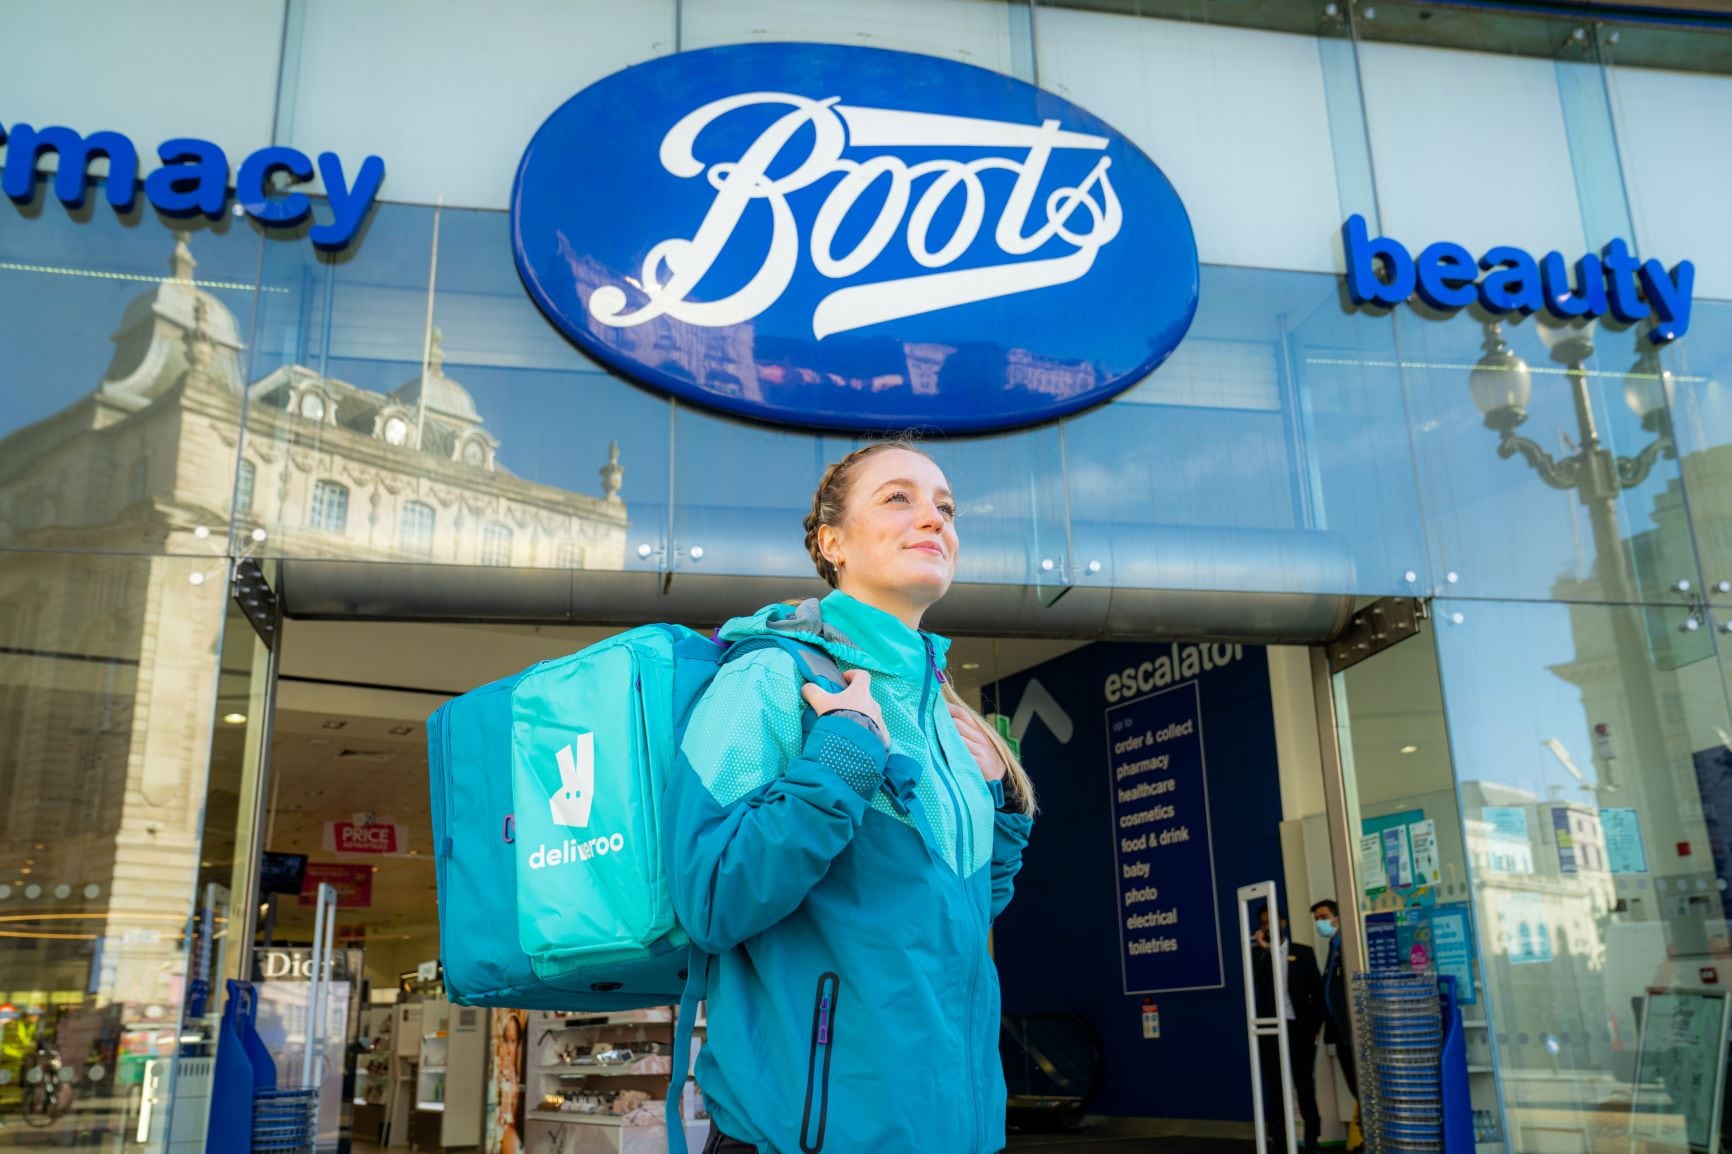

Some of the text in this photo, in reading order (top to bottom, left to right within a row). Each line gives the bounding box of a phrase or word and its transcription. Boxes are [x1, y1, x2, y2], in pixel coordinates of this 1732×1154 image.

[0, 121, 386, 252] macy
[588, 92, 1123, 341] Boots
[1342, 213, 1696, 345] beauty
[1115, 719, 1193, 754] order & collect
[1117, 755, 1169, 780] pharmacy
[1118, 779, 1175, 802] healthcare
[1120, 805, 1175, 827] cosmetics
[342, 826, 390, 843] PRICE
[1121, 826, 1190, 853] food & drink
[1123, 861, 1150, 879] baby
[1125, 886, 1158, 906] photo
[1127, 908, 1178, 929] electrical
[1128, 937, 1178, 956] toiletries
[263, 952, 336, 978] Dio
